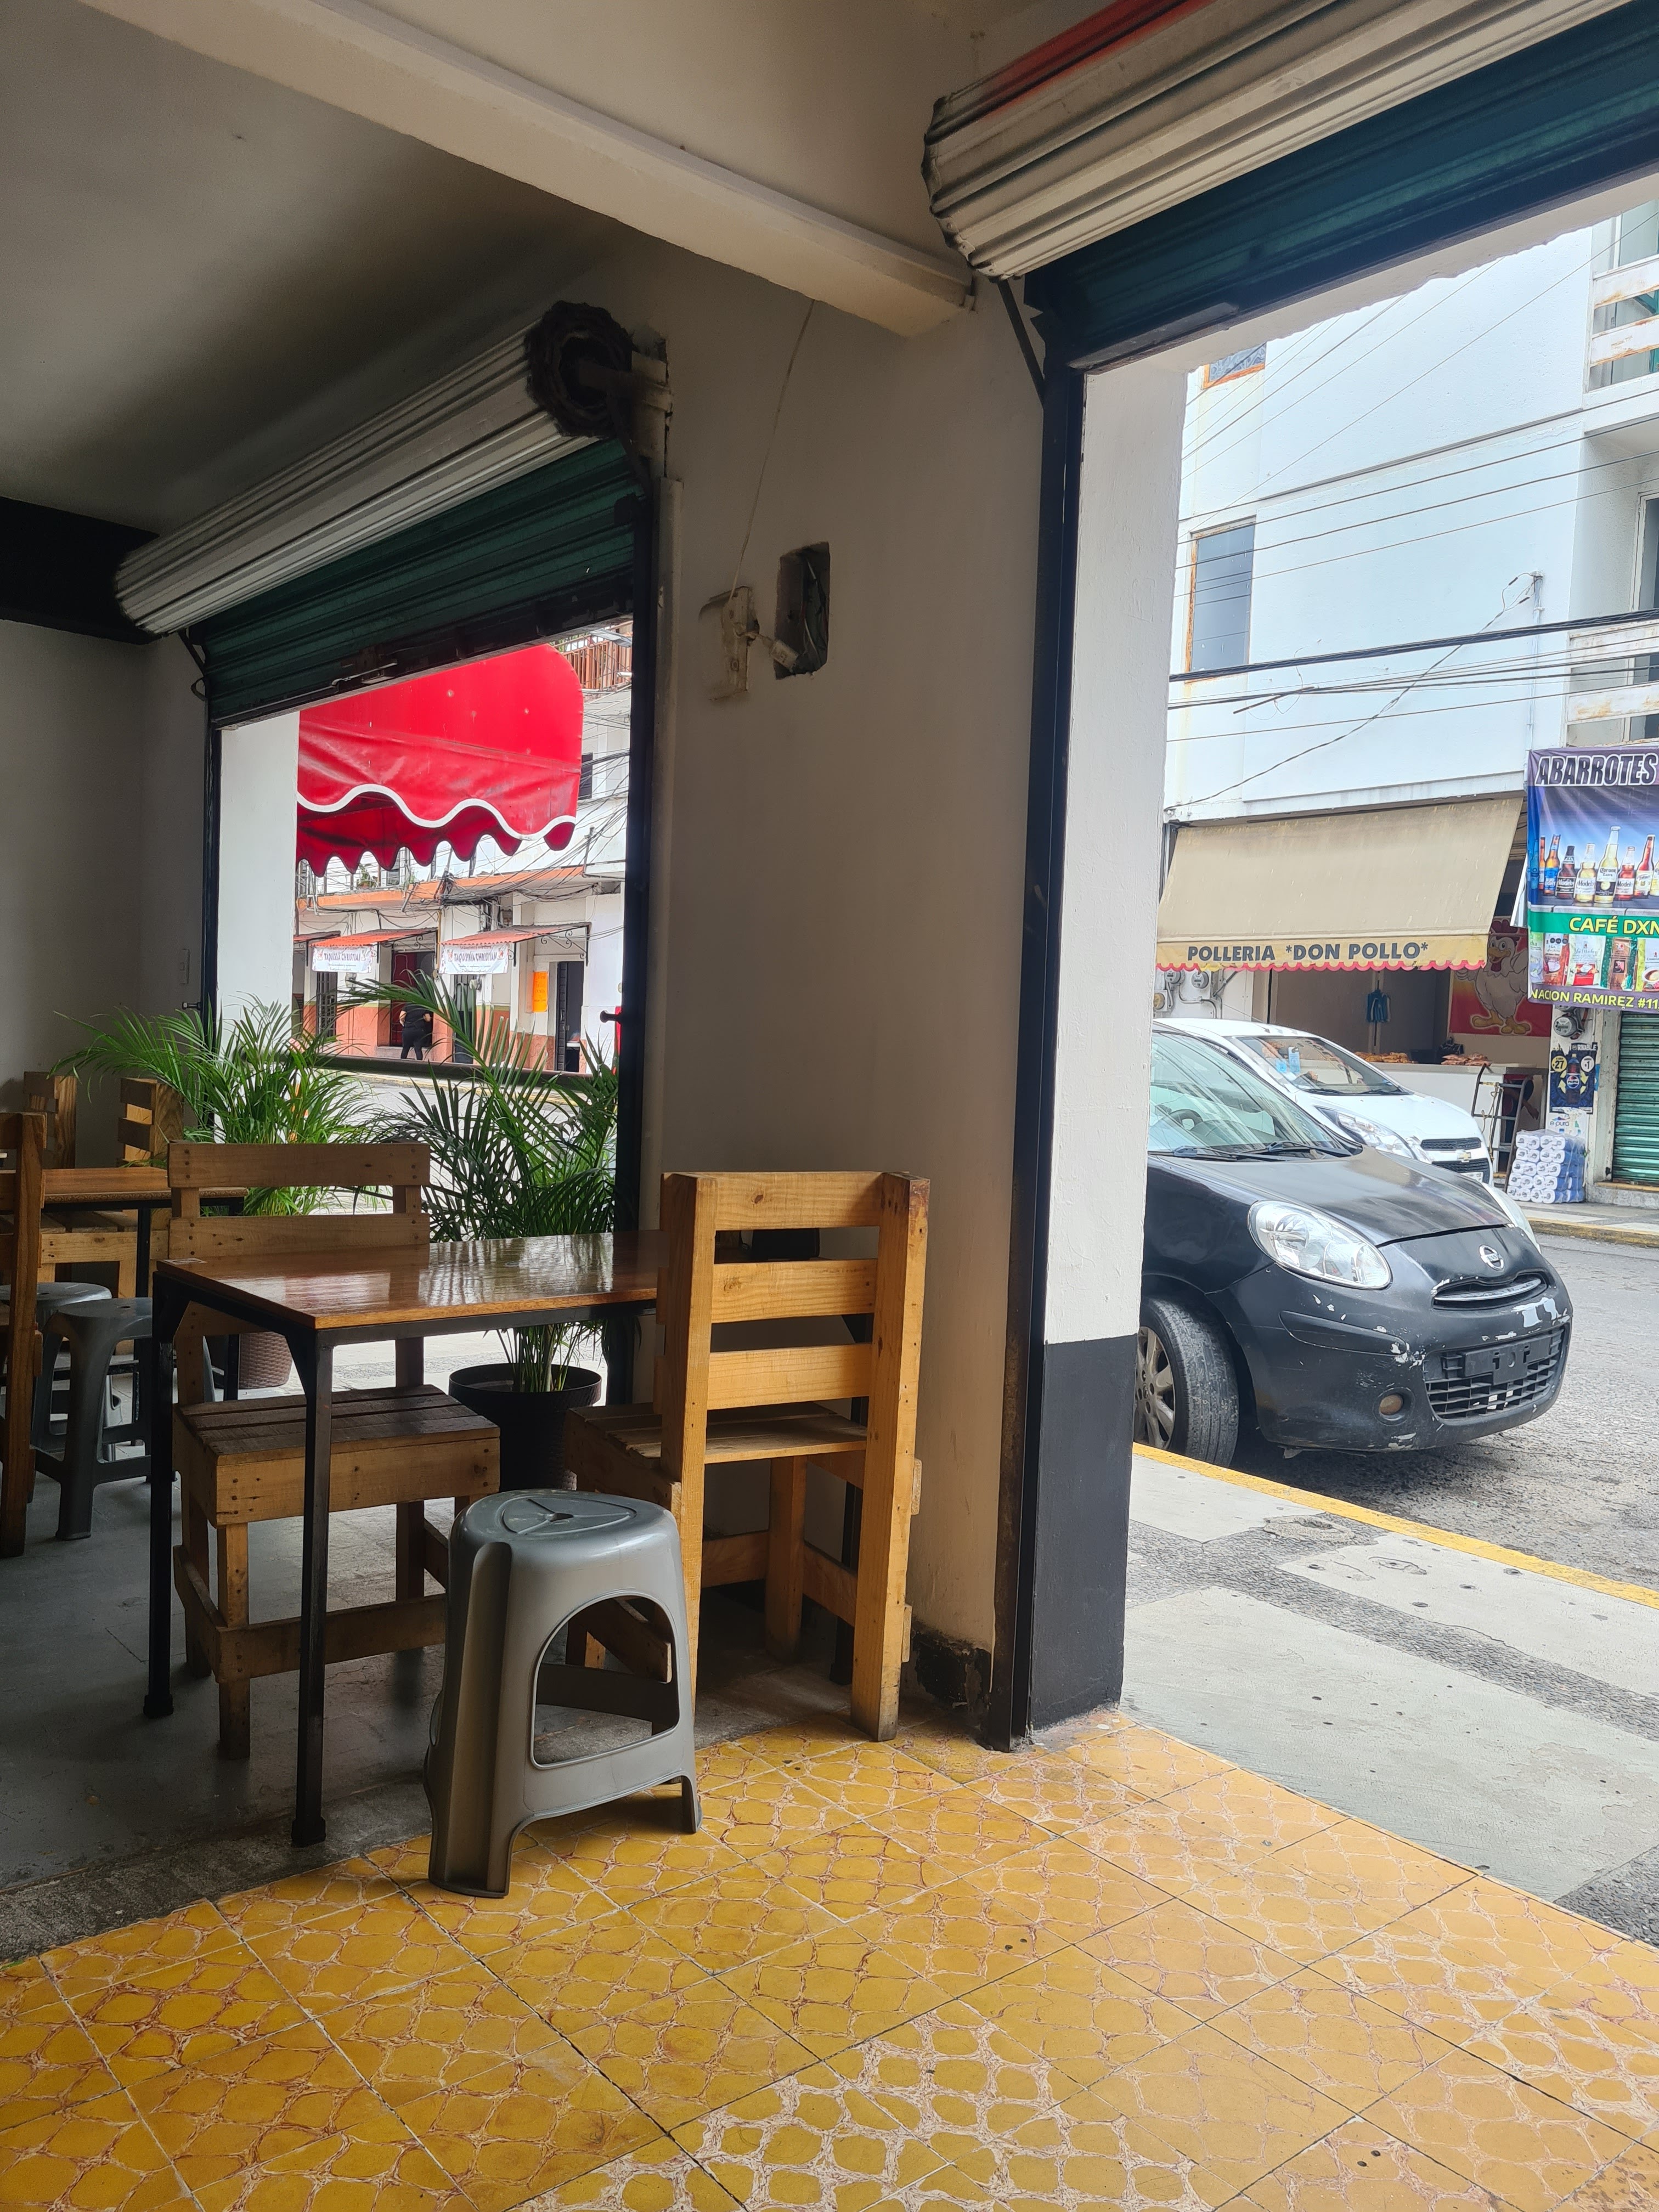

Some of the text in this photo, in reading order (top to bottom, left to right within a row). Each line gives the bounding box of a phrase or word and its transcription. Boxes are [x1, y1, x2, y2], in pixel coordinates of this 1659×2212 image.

[1535, 753, 1658, 786] ABARROTES
[1569, 915, 1618, 933] CAFÉ
[1188, 945, 1276, 961] POLLERIA
[1573, 992, 1635, 1008] RAMIREZ
